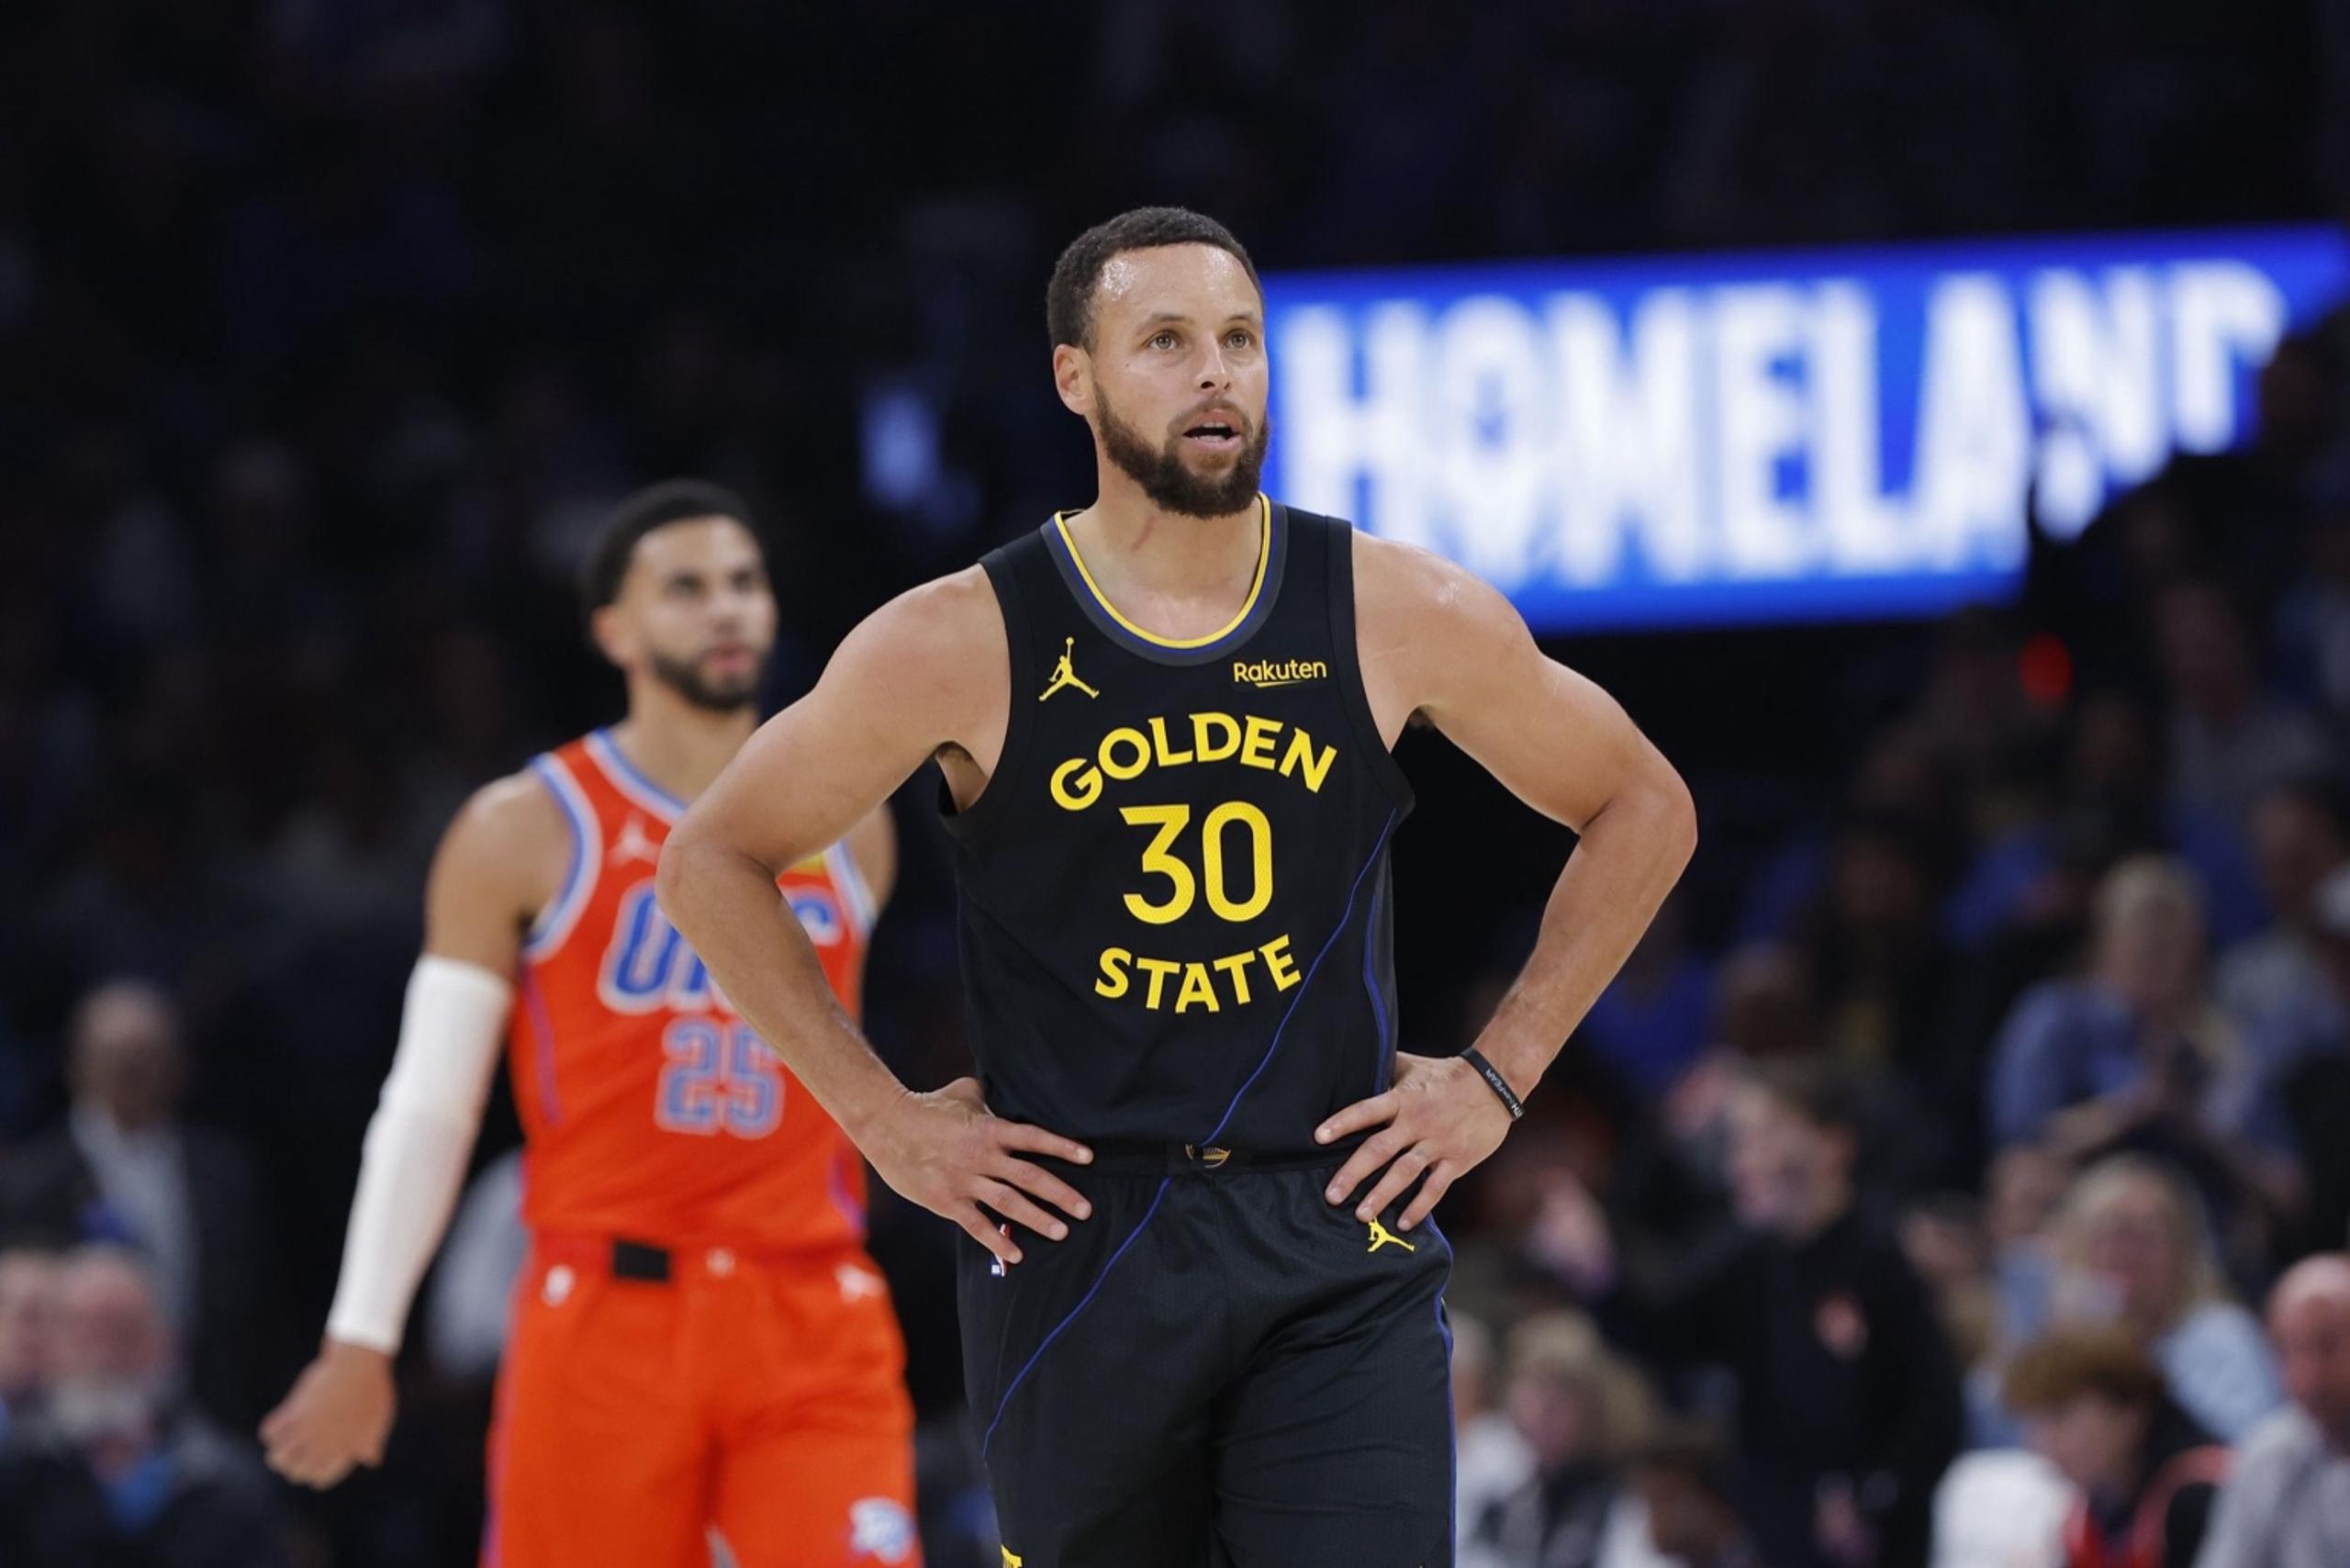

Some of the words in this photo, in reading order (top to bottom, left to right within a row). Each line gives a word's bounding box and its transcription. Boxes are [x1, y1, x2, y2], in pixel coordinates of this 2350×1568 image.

[1233, 659, 1327, 683] Rakuten
[1049, 711, 1338, 812] GOLDEN
[1118, 801, 1274, 925] 30
[1094, 934, 1302, 1014] STATE
[655, 1013, 787, 1139] 25
